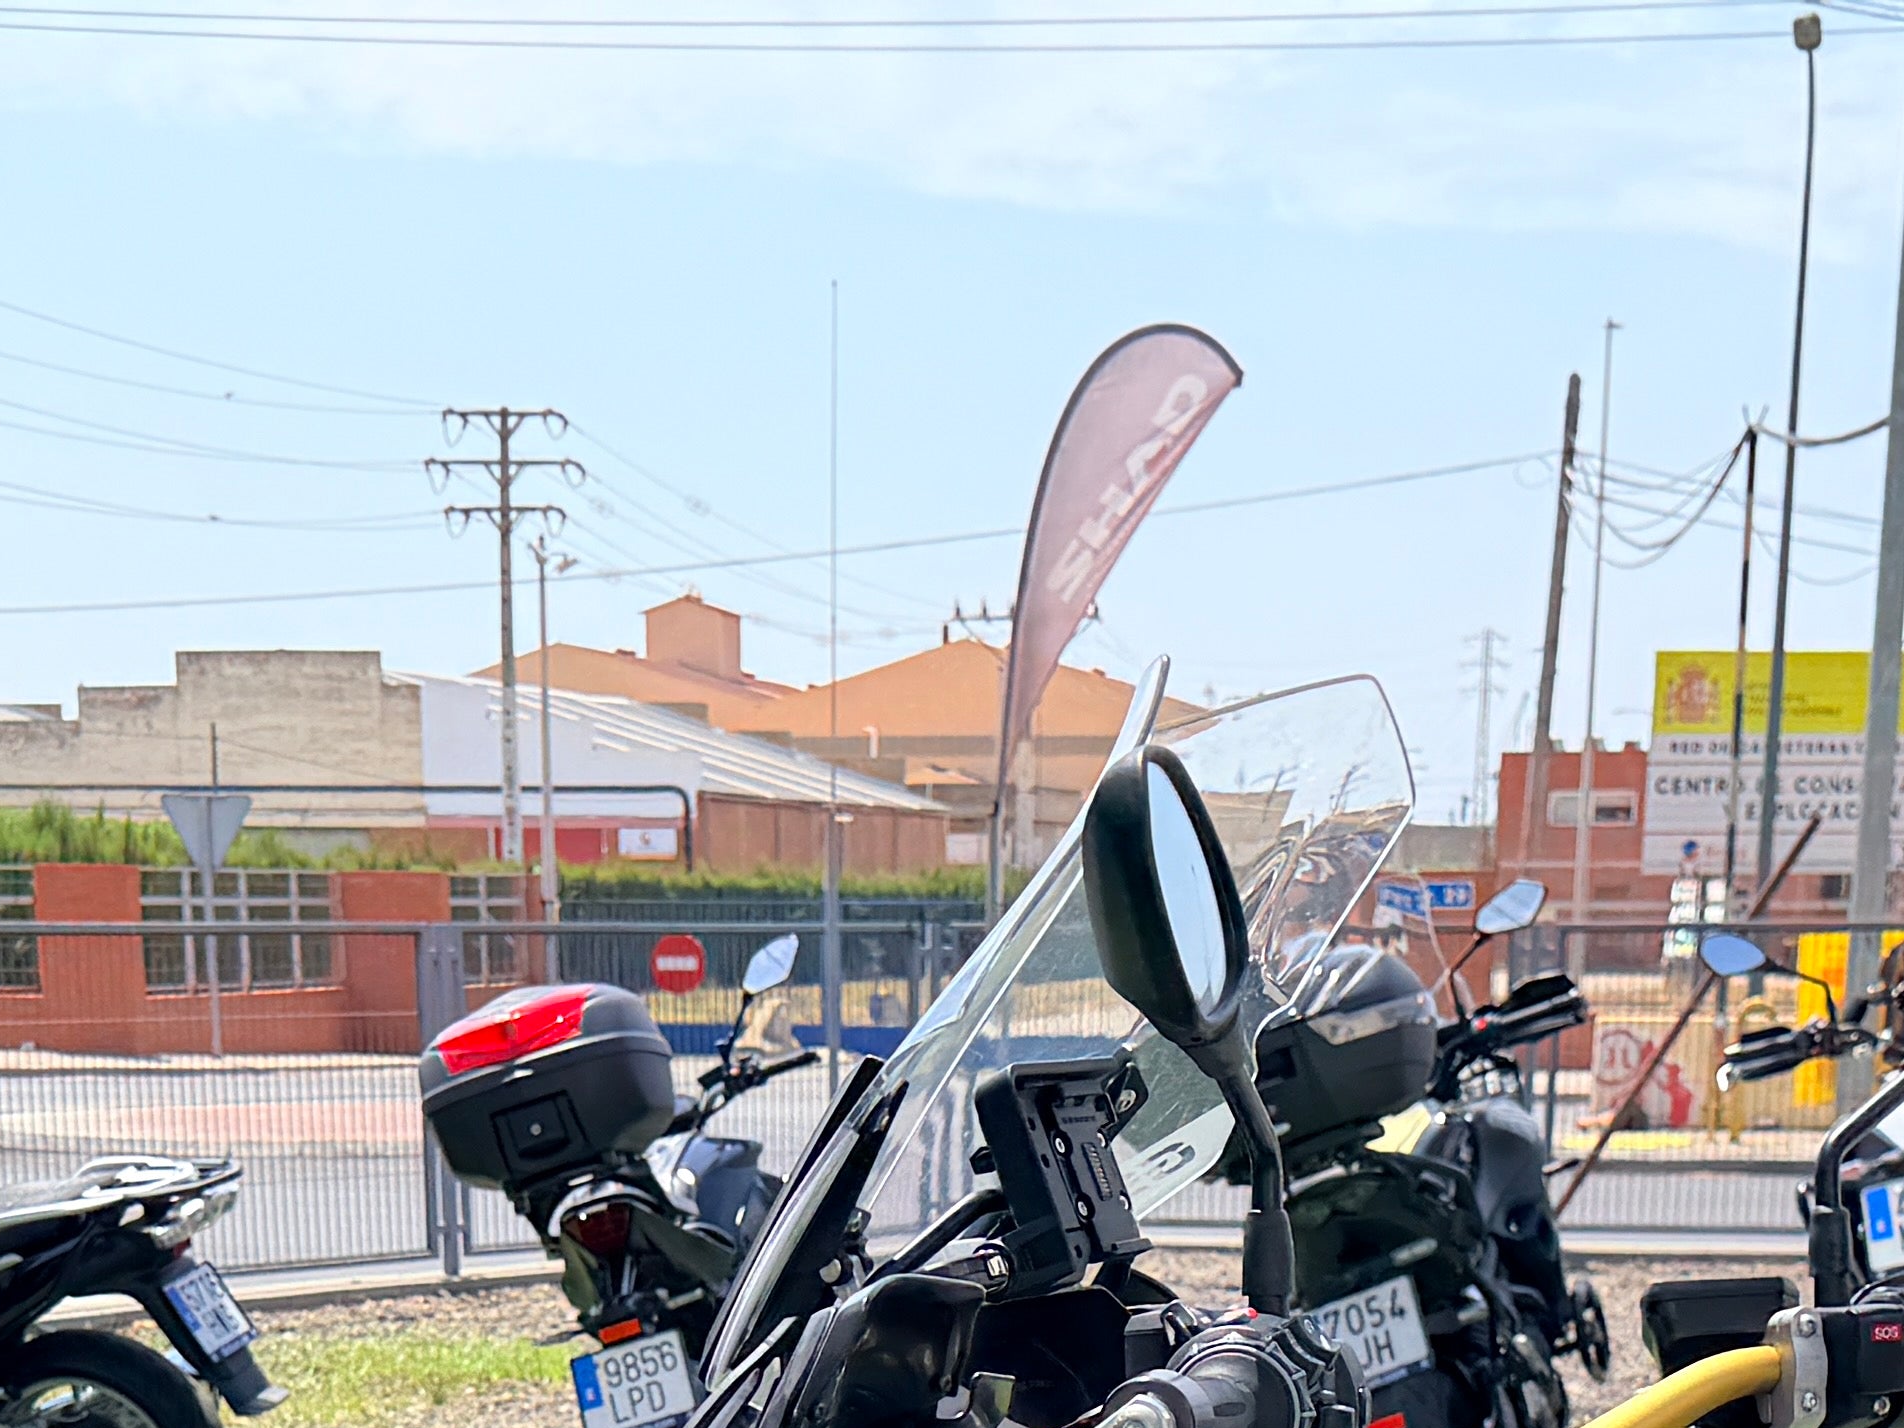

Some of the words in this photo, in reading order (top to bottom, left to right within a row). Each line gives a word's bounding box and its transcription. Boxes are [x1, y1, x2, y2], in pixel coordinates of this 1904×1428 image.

[1322, 1287, 1407, 1340] 7054
[1874, 1325, 1899, 1341] SOS
[604, 1340, 678, 1389] 9856
[1360, 1328, 1395, 1370] JH
[608, 1379, 667, 1424] LPD
